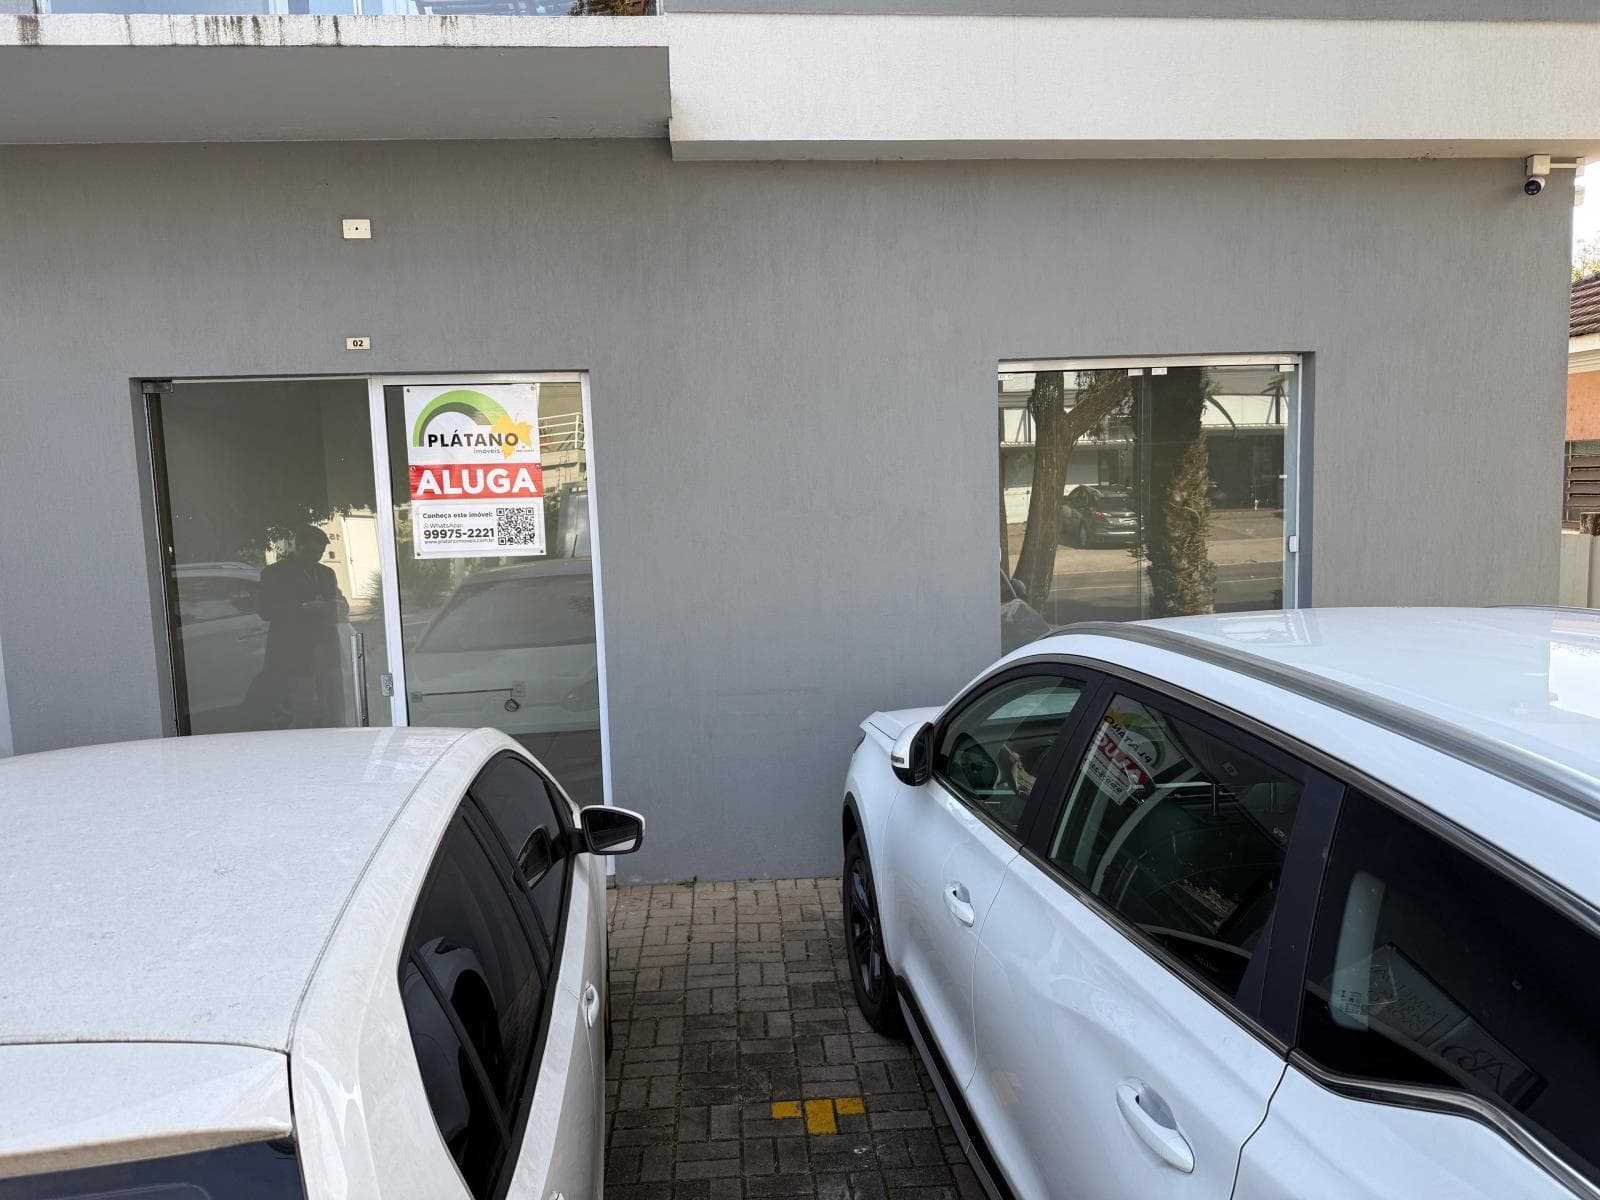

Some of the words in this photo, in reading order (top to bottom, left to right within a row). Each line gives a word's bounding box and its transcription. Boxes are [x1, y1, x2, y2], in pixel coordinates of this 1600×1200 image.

[352, 339, 364, 347] 02
[427, 429, 519, 448] PLÁTANO
[416, 467, 538, 497] ALUGA
[422, 512, 452, 520] Conheça
[423, 527, 495, 540] 99975-2221
